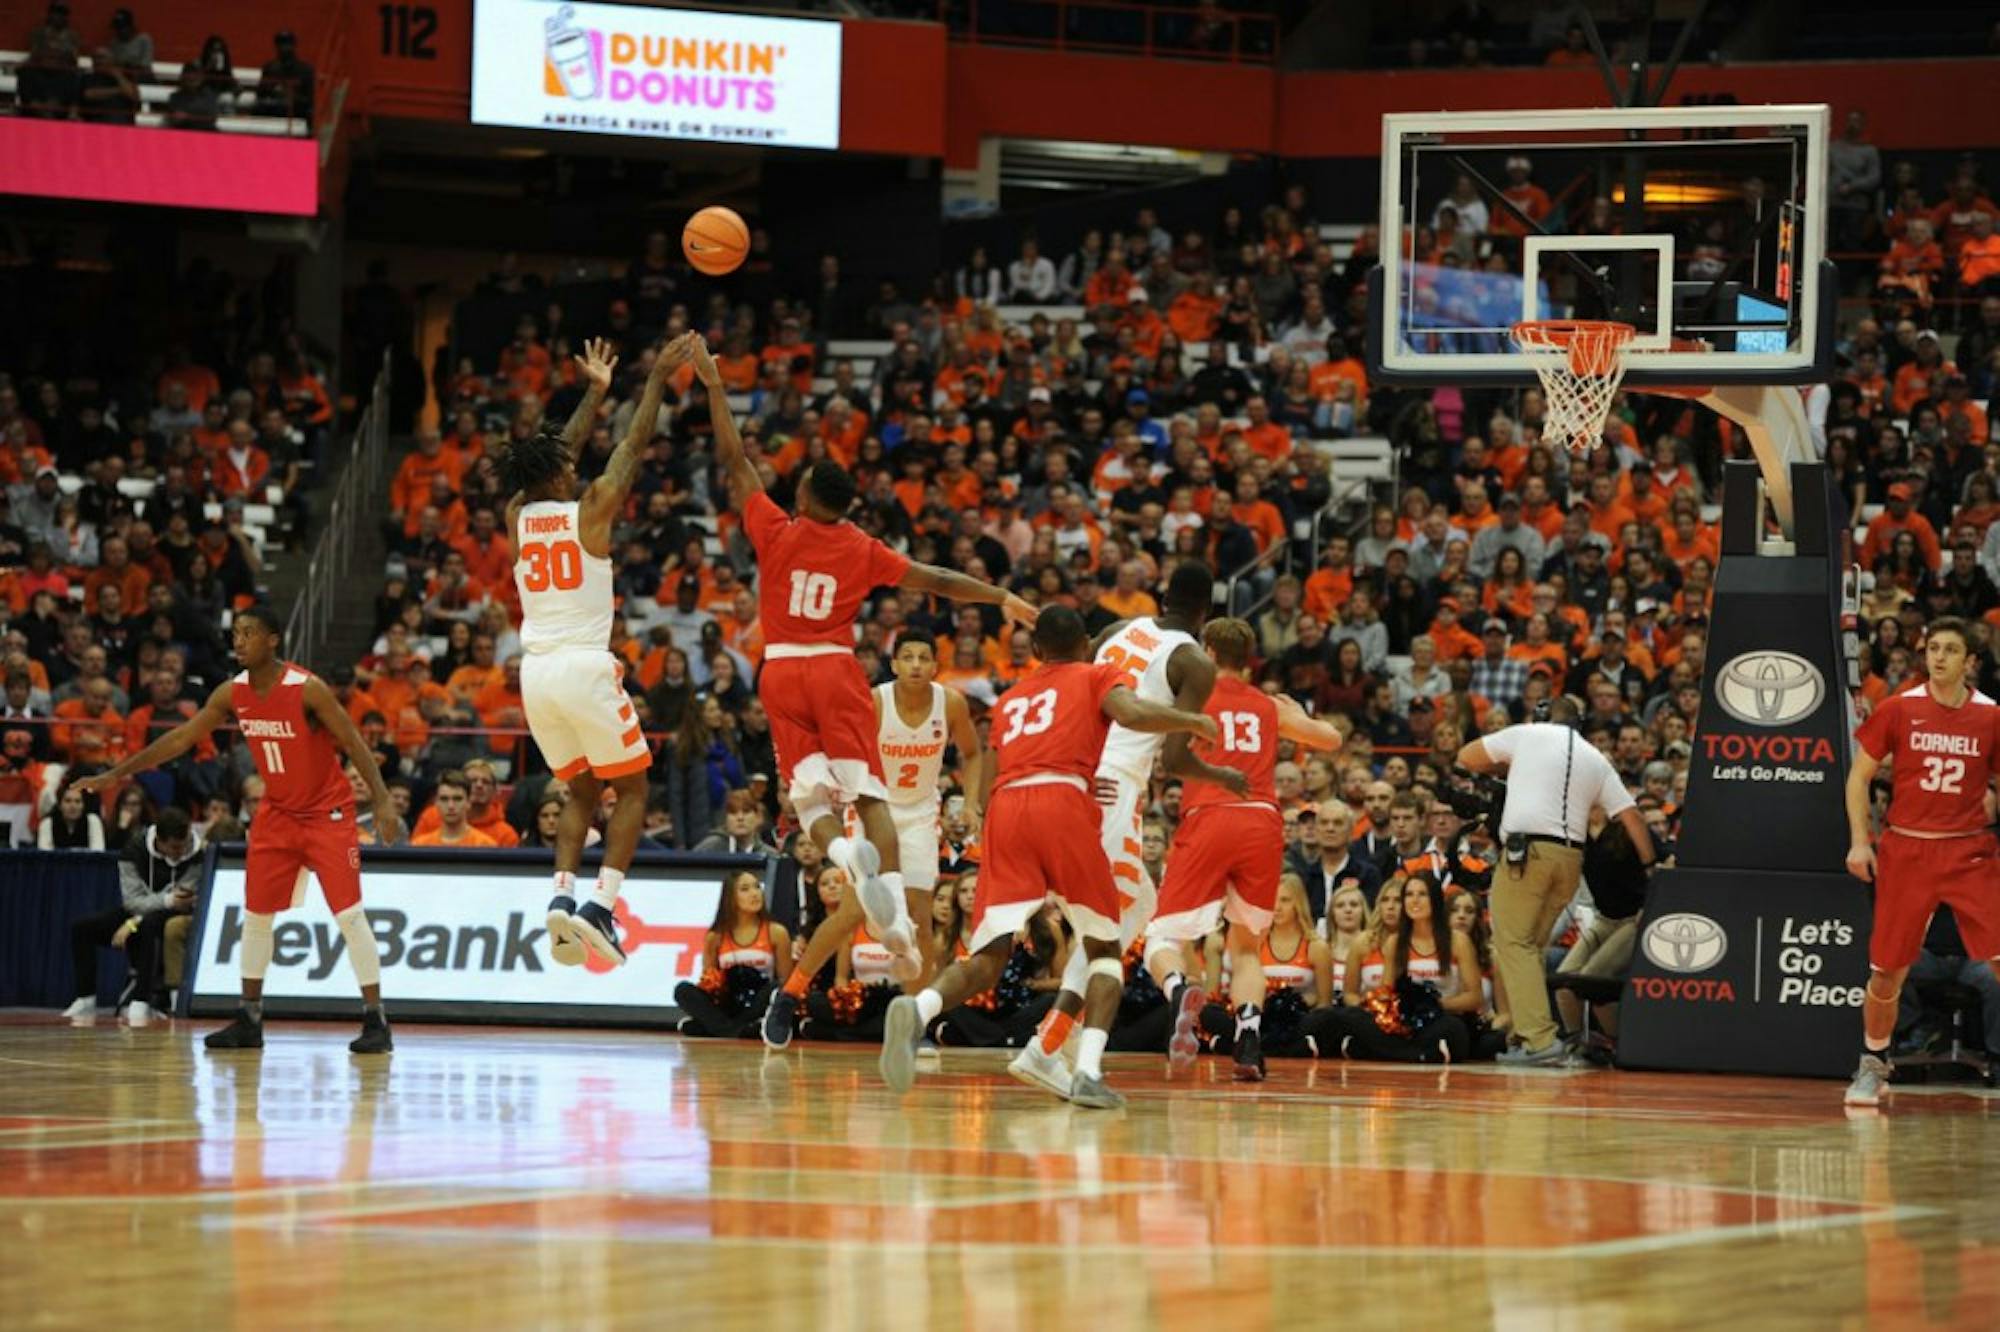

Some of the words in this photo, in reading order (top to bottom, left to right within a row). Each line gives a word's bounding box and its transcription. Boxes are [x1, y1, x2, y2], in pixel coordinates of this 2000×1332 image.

[379, 5, 438, 60] 112
[610, 33, 785, 75] DUNKIN'
[610, 70, 775, 113] DONUTS
[544, 114, 618, 128] AMERICA
[629, 118, 670, 132] RUNS
[679, 121, 702, 133] ON
[525, 514, 570, 533] THORPE
[521, 540, 583, 592] 30
[789, 569, 838, 619] 10
[239, 719, 296, 739] CORNELL
[1002, 688, 1057, 746] 33
[1219, 711, 1261, 752] 13
[262, 741, 285, 773] 11
[1702, 734, 1836, 763] TOYOTA
[1910, 731, 1980, 757] CORNELL
[897, 764, 919, 788] 2
[1713, 765, 1747, 780] Let's
[1751, 765, 1773, 780] Go
[1775, 767, 1824, 783] Places
[1920, 757, 1965, 793] 32
[215, 906, 546, 979] KeyBank
[1781, 917, 1853, 945] Let's
[1779, 947, 1822, 974] Go
[1632, 978, 1735, 1001] TOYOTA
[1779, 977, 1865, 1007] Place
